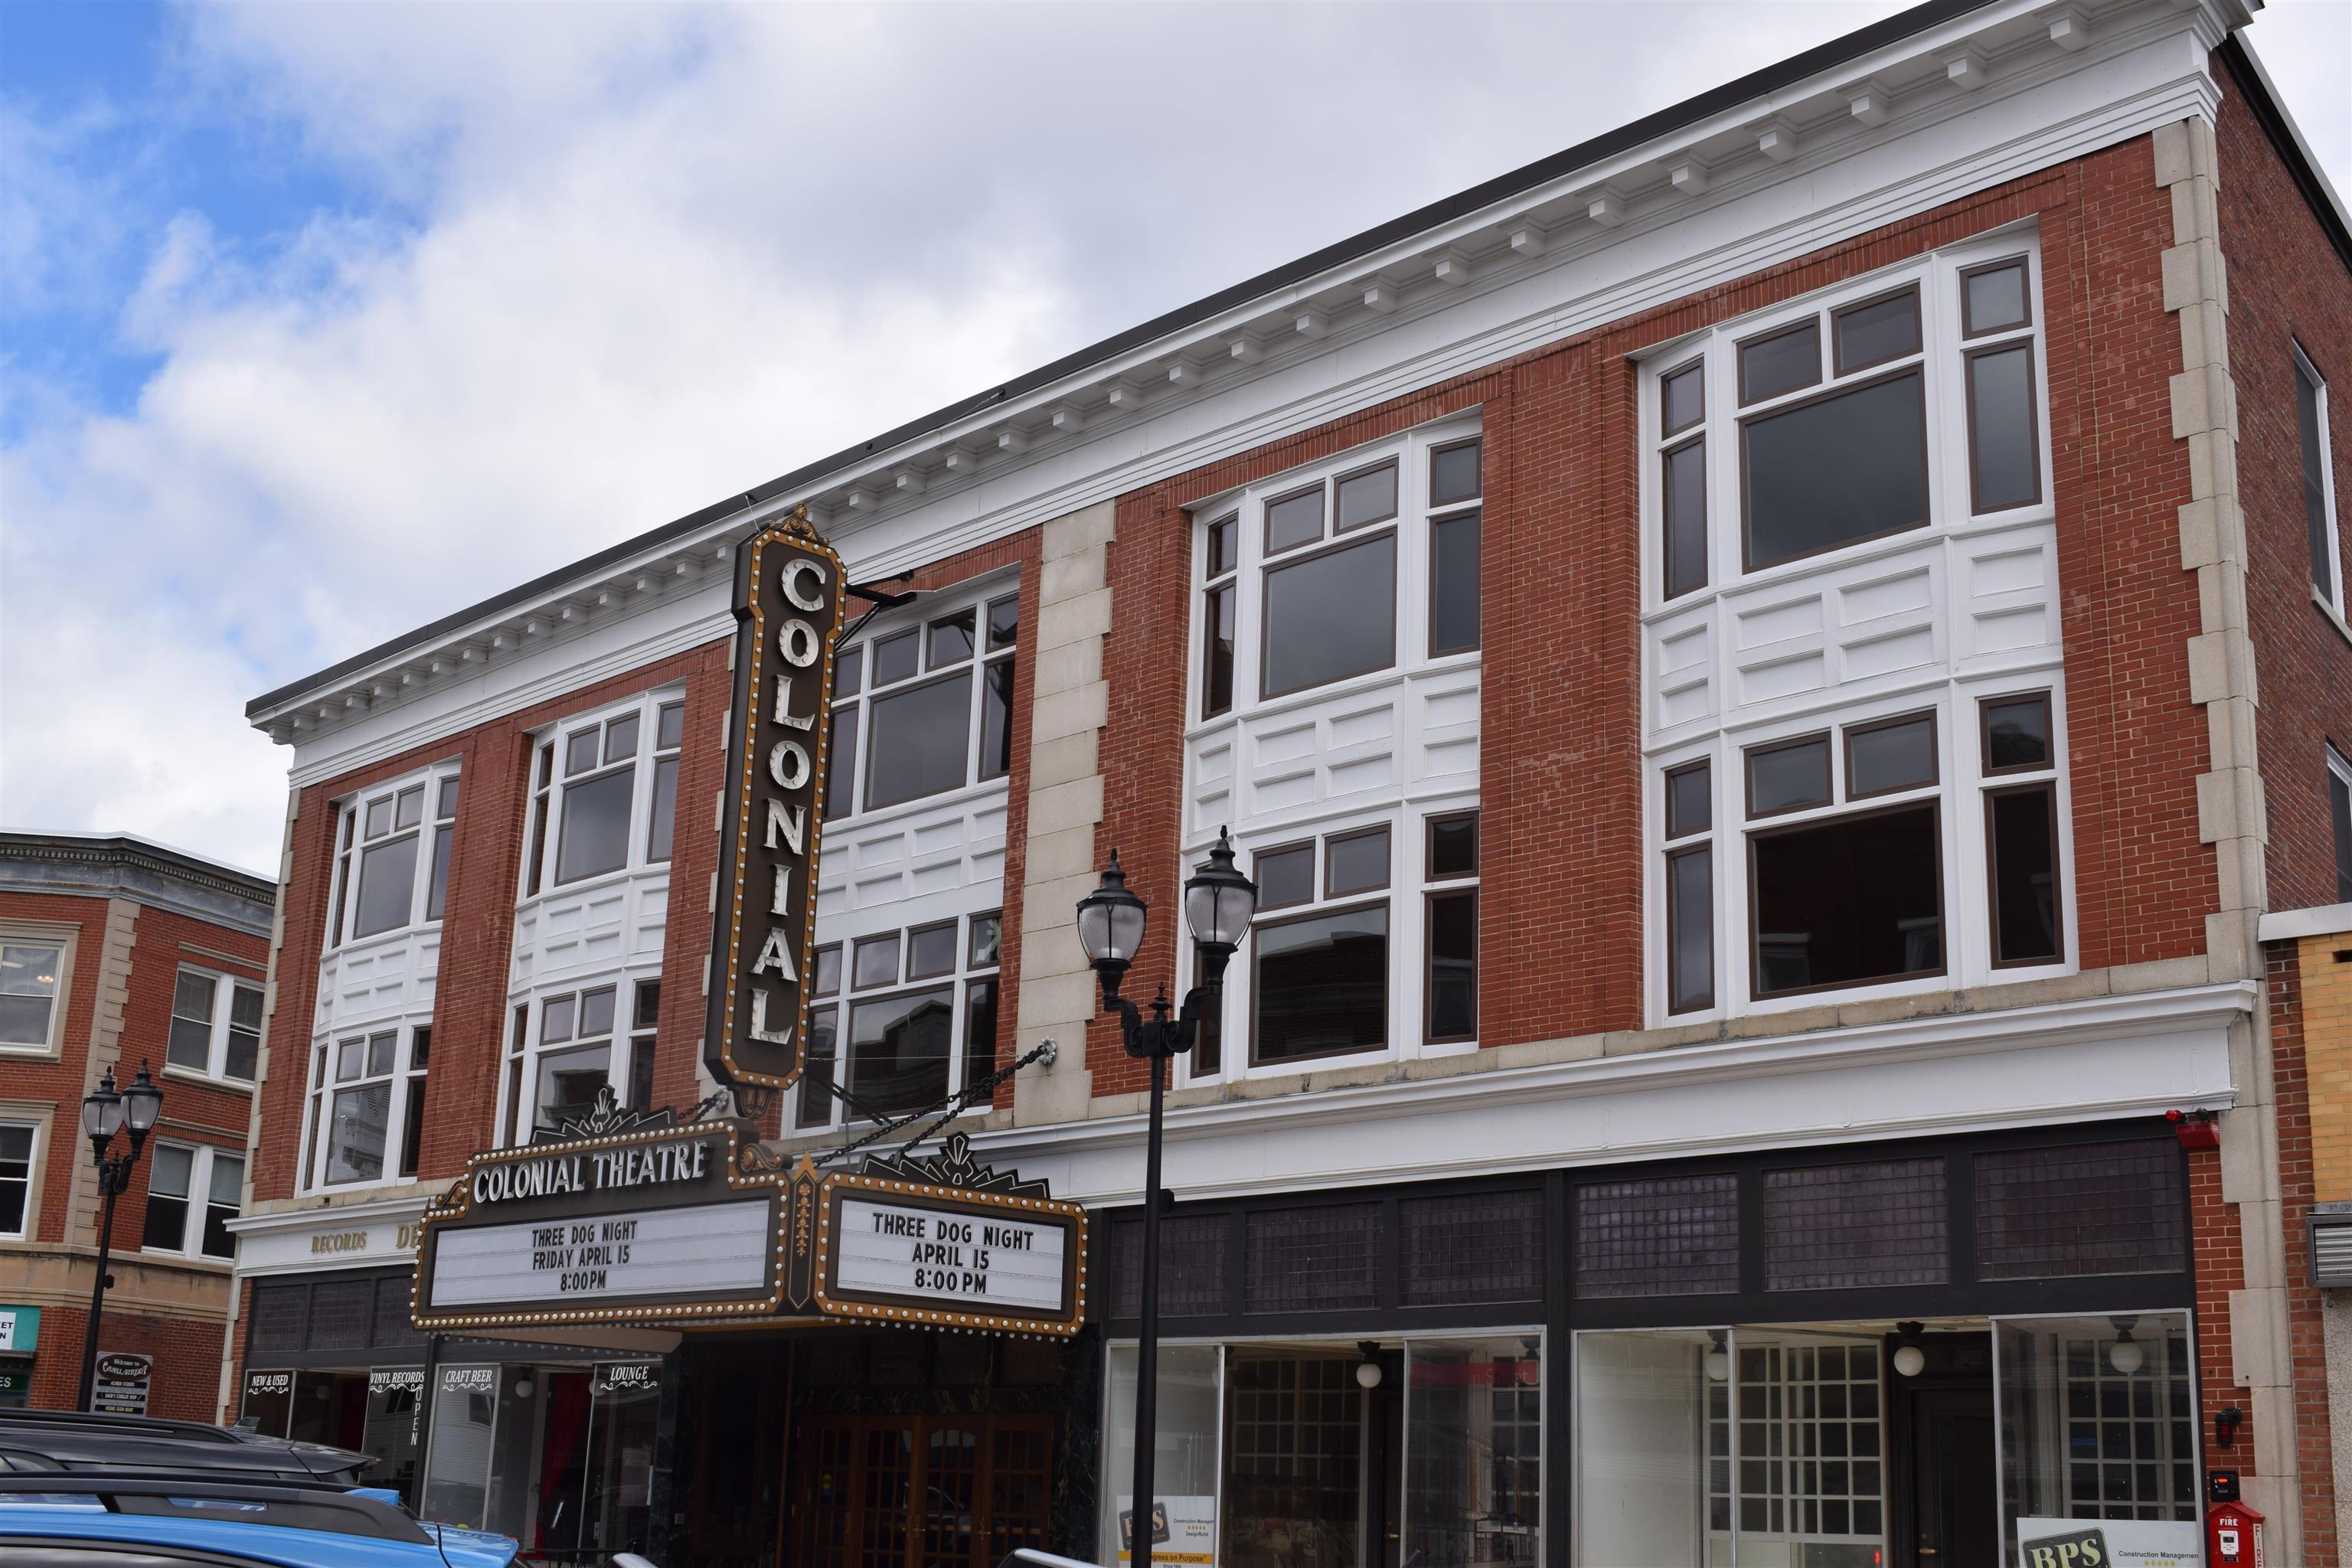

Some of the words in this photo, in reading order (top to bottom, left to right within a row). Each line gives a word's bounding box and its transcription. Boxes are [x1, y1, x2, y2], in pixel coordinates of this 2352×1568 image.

[746, 558, 827, 1045] COLONIAL
[474, 1155, 586, 1204] COLONIAL
[593, 1140, 708, 1189] THEATRE
[311, 1231, 368, 1254] RECORDS
[532, 1227, 565, 1248] THREE
[571, 1224, 595, 1245] DOG
[602, 1220, 638, 1241] NIGHT
[873, 1212, 926, 1238] THREE
[936, 1220, 972, 1243] DOG
[983, 1227, 1034, 1251] NIGHT
[532, 1249, 573, 1270] FRIDAY
[578, 1246, 612, 1266] APRIL
[617, 1244, 631, 1264] 15
[912, 1242, 963, 1267] APRIL
[973, 1249, 990, 1269] 15
[252, 1375, 266, 1387] NEW
[266, 1375, 272, 1386] &
[272, 1374, 289, 1386] USED
[371, 1371, 390, 1384] VINYL
[391, 1370, 424, 1384] RECORDS
[446, 1370, 471, 1383] CRAFT
[471, 1369, 493, 1383] BEER
[610, 1366, 649, 1381] LOUNGE
[410, 1388, 423, 1446] OPEN
[2029, 1538, 2101, 1568] BPS
[2160, 1551, 2200, 1560] Managemen
